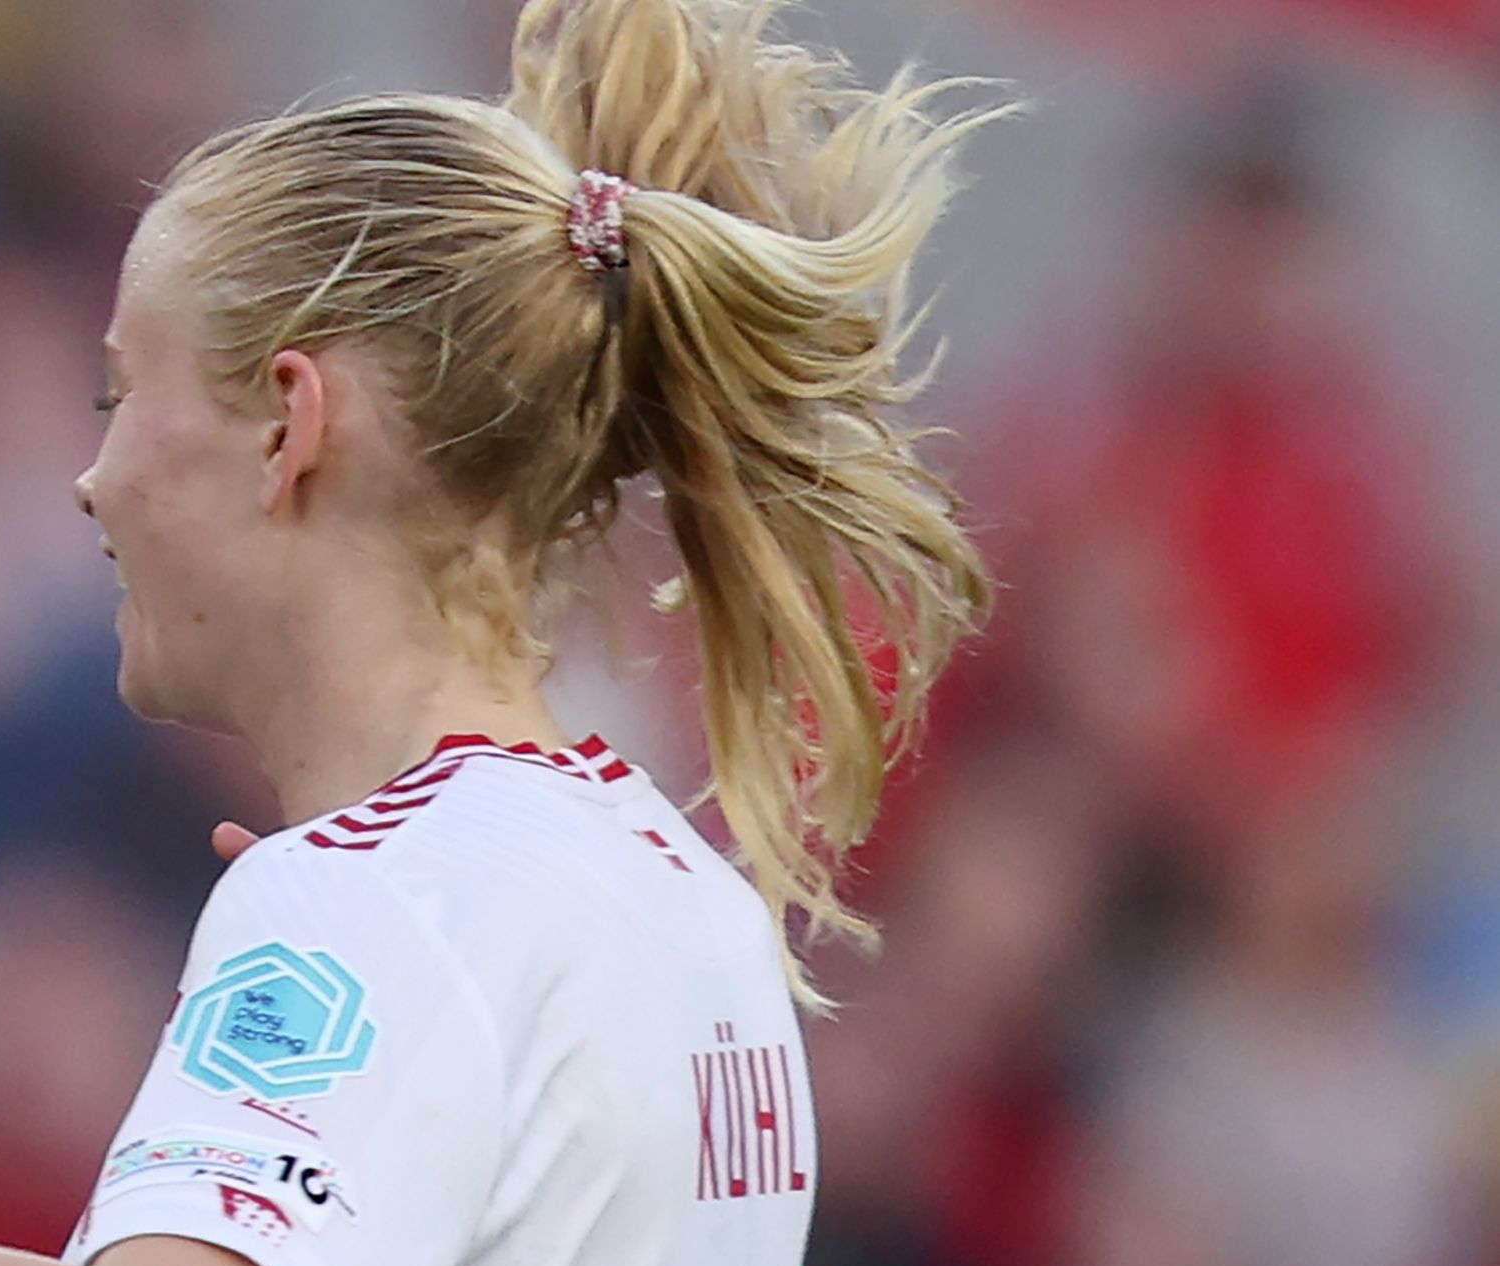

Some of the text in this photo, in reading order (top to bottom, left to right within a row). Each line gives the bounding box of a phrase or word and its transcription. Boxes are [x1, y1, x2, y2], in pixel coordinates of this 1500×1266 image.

[234, 1006, 286, 1031] play
[228, 1025, 307, 1055] strong
[691, 1020, 806, 1200] KÜHL
